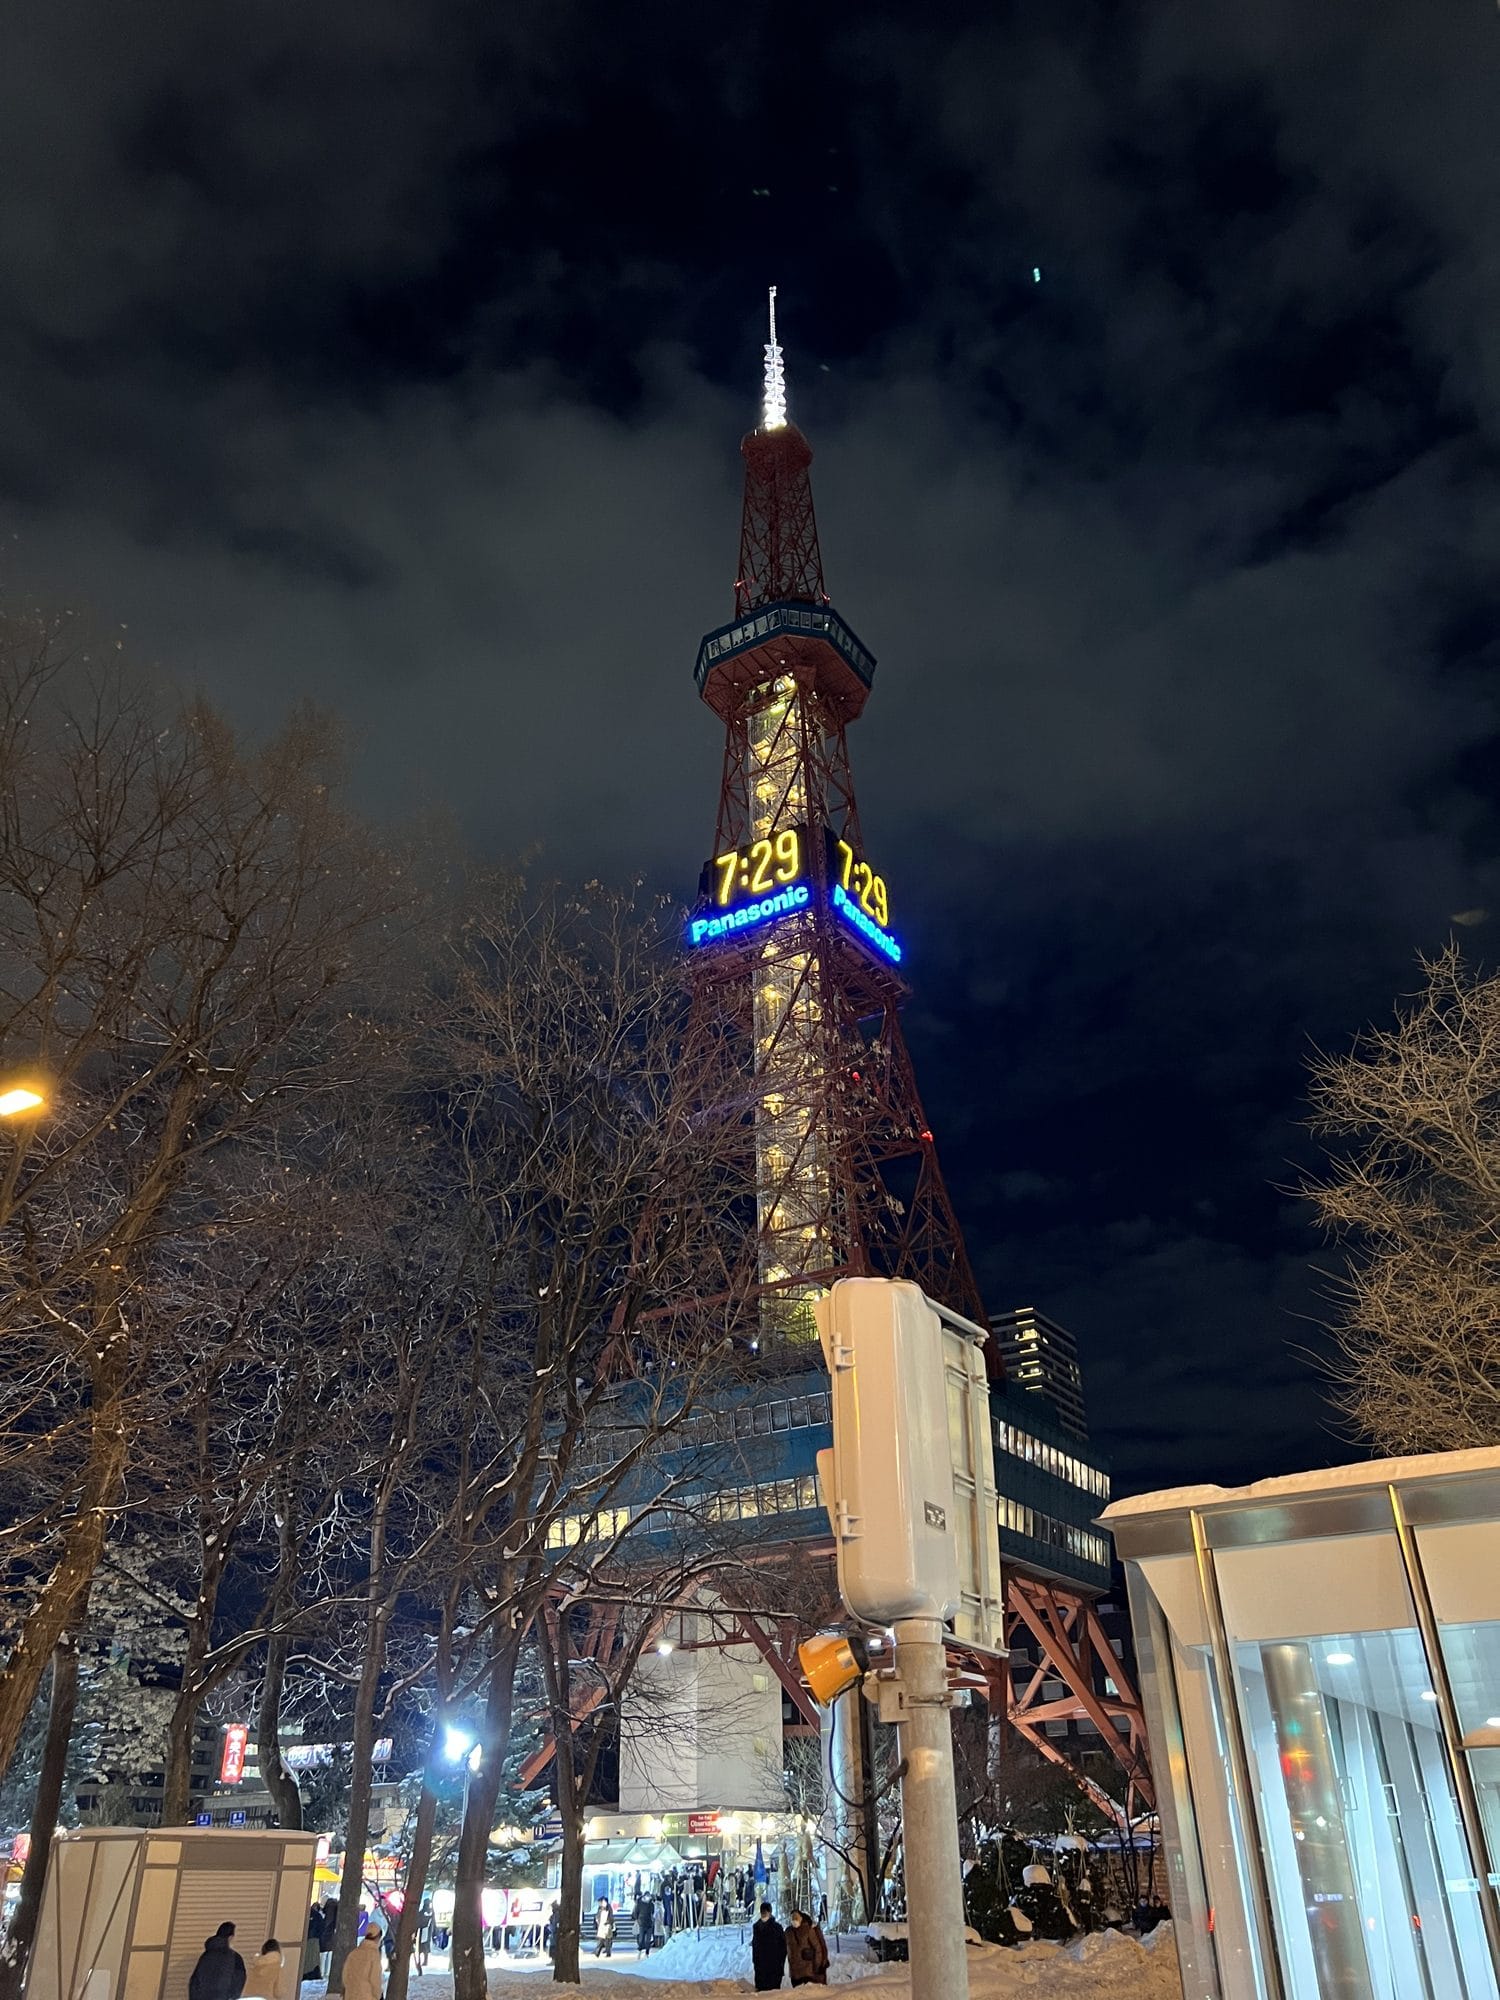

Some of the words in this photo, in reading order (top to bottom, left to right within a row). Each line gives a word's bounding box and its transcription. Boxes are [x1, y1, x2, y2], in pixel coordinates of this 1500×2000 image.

[716, 830, 800, 904] 7:29
[838, 839, 889, 926] 7:29
[691, 885, 809, 943] Panasonic
[834, 884, 902, 962] Panasonic
